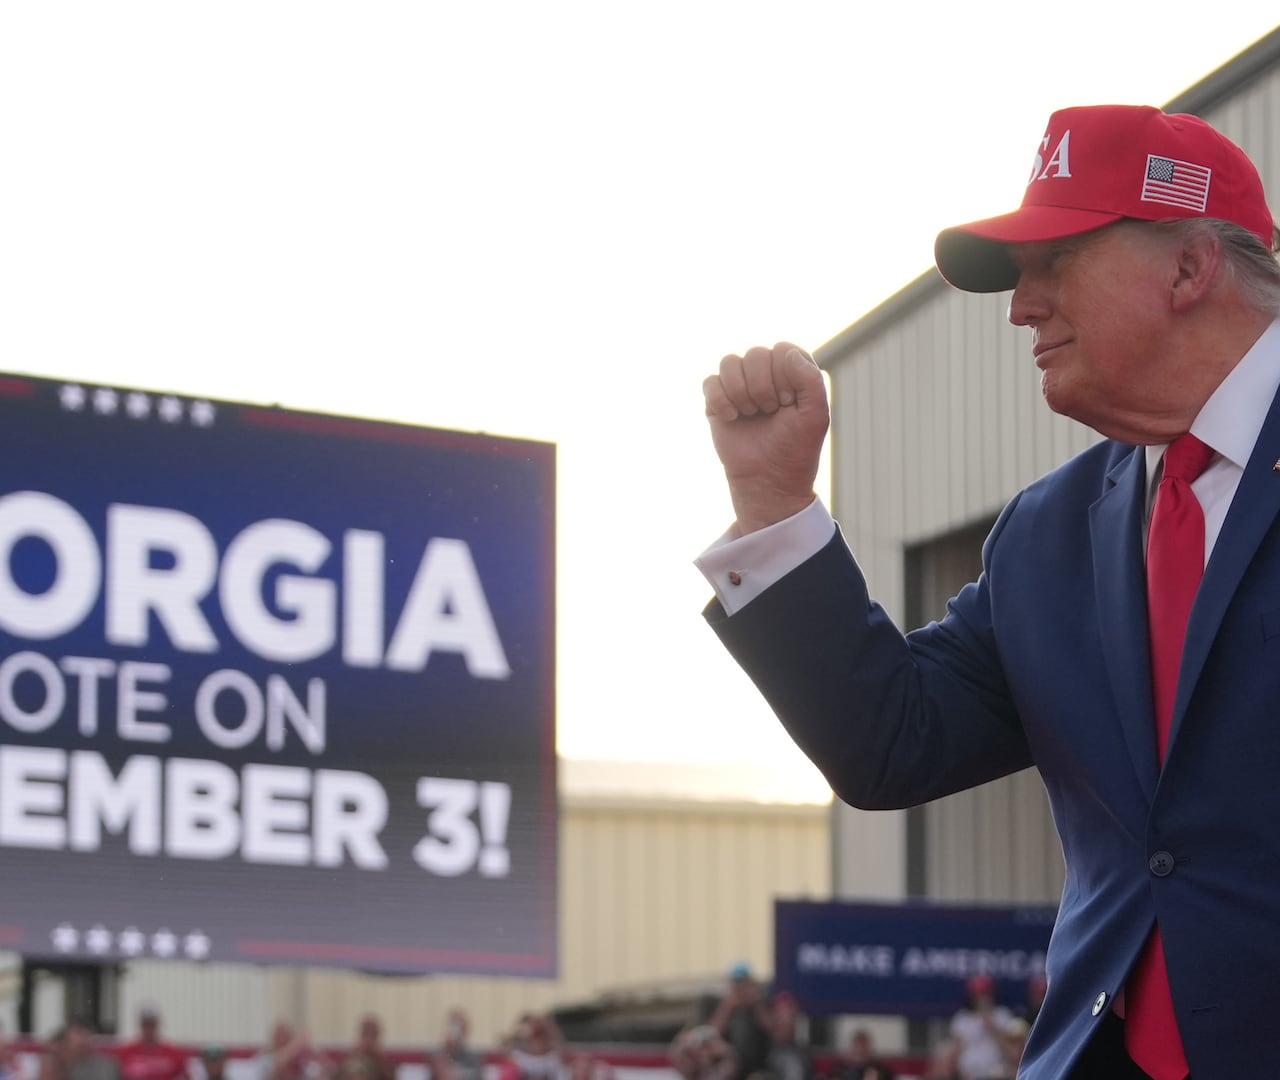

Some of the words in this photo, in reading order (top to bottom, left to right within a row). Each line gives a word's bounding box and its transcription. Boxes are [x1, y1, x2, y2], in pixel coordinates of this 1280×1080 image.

[1028, 129, 1073, 185] SA
[195, 669, 325, 751] ON
[413, 777, 511, 878] 3!
[799, 944, 893, 976] MAKE
